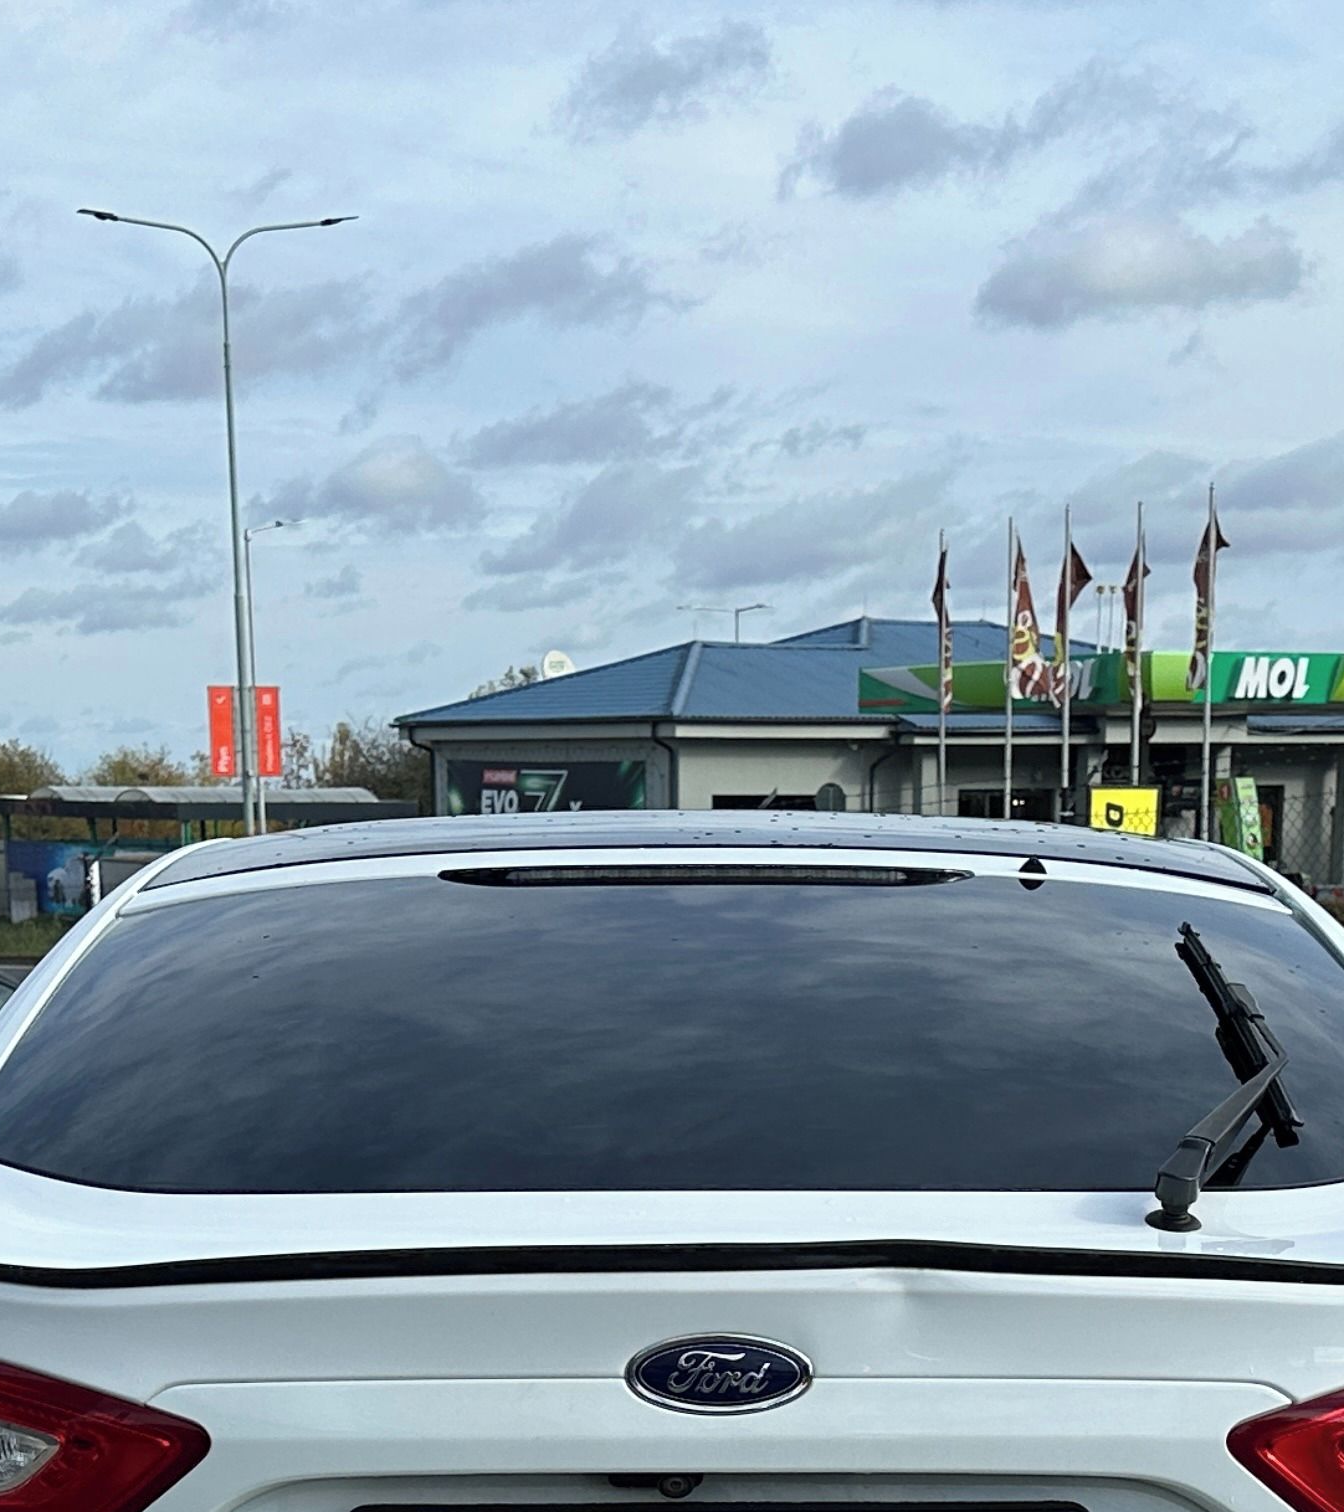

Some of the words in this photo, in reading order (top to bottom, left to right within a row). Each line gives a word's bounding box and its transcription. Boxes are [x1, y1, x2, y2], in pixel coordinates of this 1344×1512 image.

[1234, 656, 1310, 699] MOL
[480, 789, 518, 815] EVO
[667, 1350, 771, 1394] Ford
